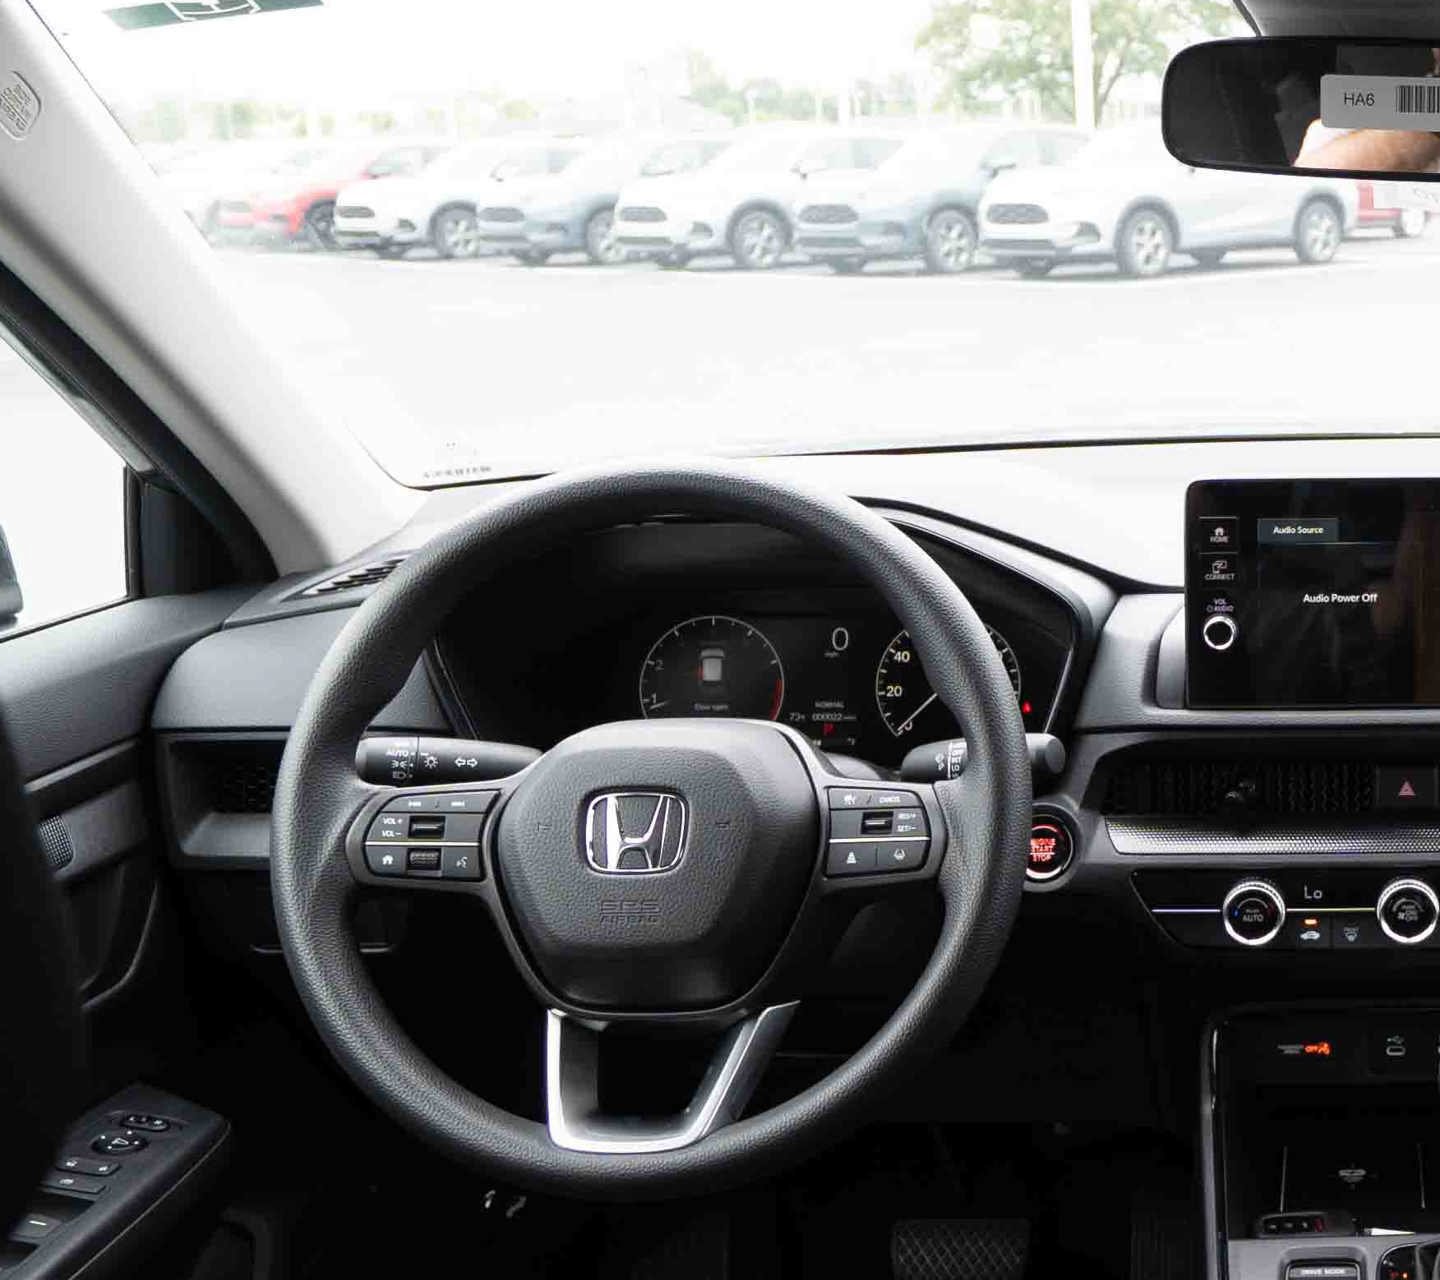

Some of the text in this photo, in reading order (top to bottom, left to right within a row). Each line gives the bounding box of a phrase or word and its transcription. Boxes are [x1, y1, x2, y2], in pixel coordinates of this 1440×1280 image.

[1344, 92, 1375, 106] HA6
[1273, 525, 1324, 535] Audio Source
[1303, 592, 1378, 603] Audio Power Off
[832, 627, 849, 651] 0
[894, 651, 910, 663] 40
[886, 685, 902, 697] 20
[1304, 885, 1323, 899] Lo
[1242, 913, 1264, 922] AUTO
